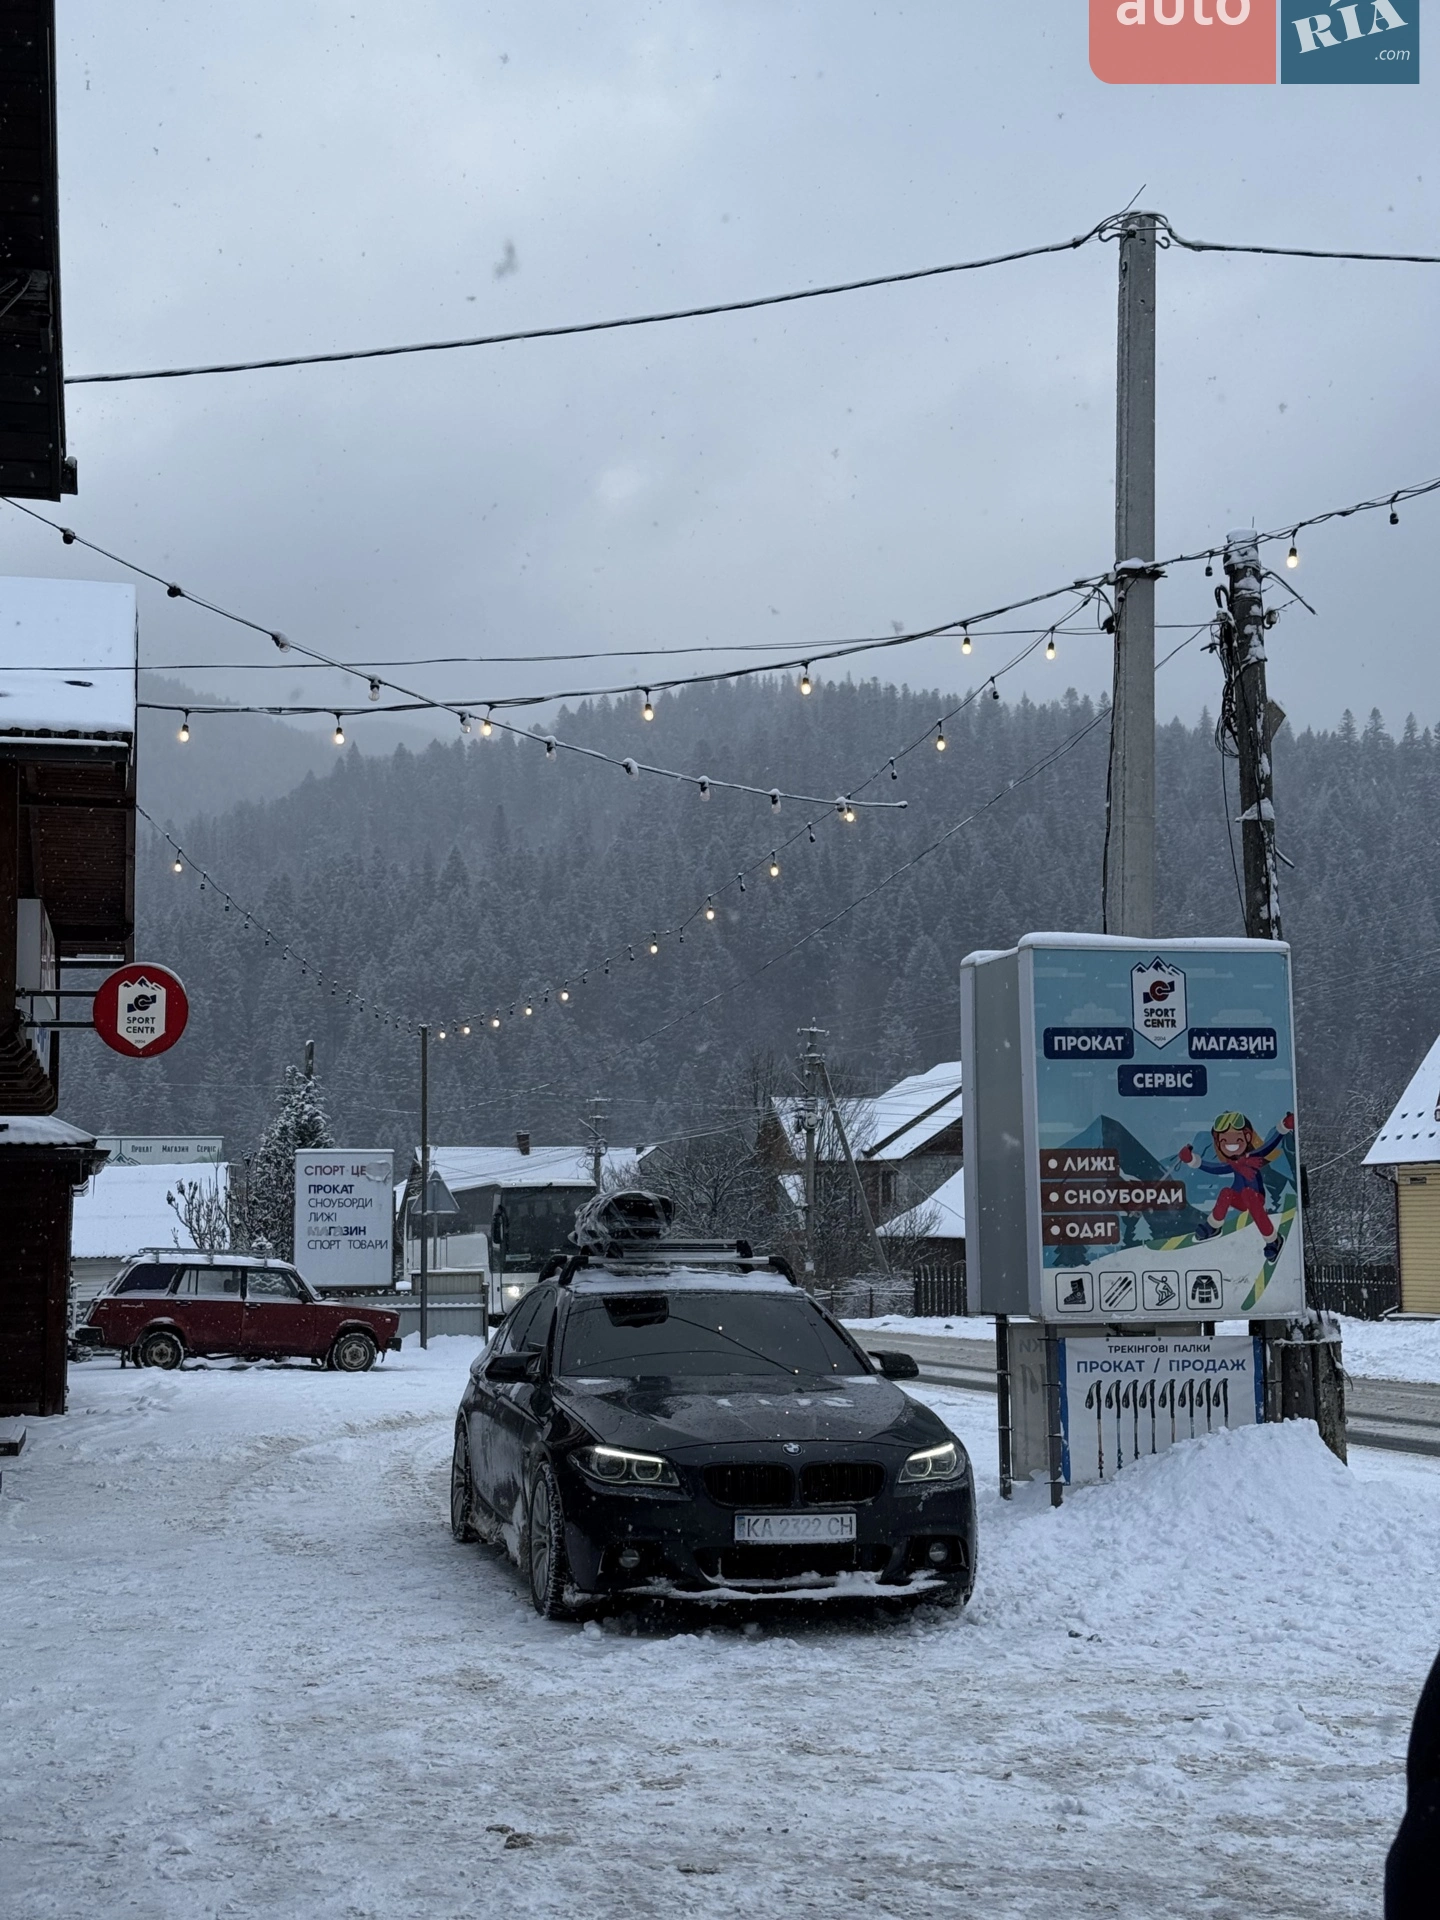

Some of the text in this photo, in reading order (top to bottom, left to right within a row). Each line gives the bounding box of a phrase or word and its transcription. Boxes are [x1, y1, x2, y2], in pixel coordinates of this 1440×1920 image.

[1143, 1007, 1176, 1018] SPORT
[126, 1016, 156, 1024] SPORT
[1143, 1018, 1177, 1028] CENTR
[125, 1026, 156, 1034] CENTR
[1053, 1035, 1124, 1052] ПРОКАТ
[1191, 1036, 1275, 1051] МАГАЗИН
[1132, 1072, 1194, 1089] СЕРВІС
[1063, 1156, 1116, 1172] ЛИЖІ
[304, 1165, 345, 1176] СПОРТ
[308, 1184, 355, 1194] ПРОКАТ
[1064, 1187, 1183, 1205] СНОУБОРДИ
[308, 1198, 373, 1209] СНОУБОРДИ
[308, 1212, 337, 1222] ЛИЖІ
[1065, 1222, 1117, 1238] ОДЯГ
[307, 1239, 388, 1250] СПОРТ ТОВАРИ
[1107, 1344, 1211, 1354] ТРЕКІНГОВІ ПАЛКИ
[1076, 1358, 1247, 1374] ПРОКАТ / ПРОДАЖ
